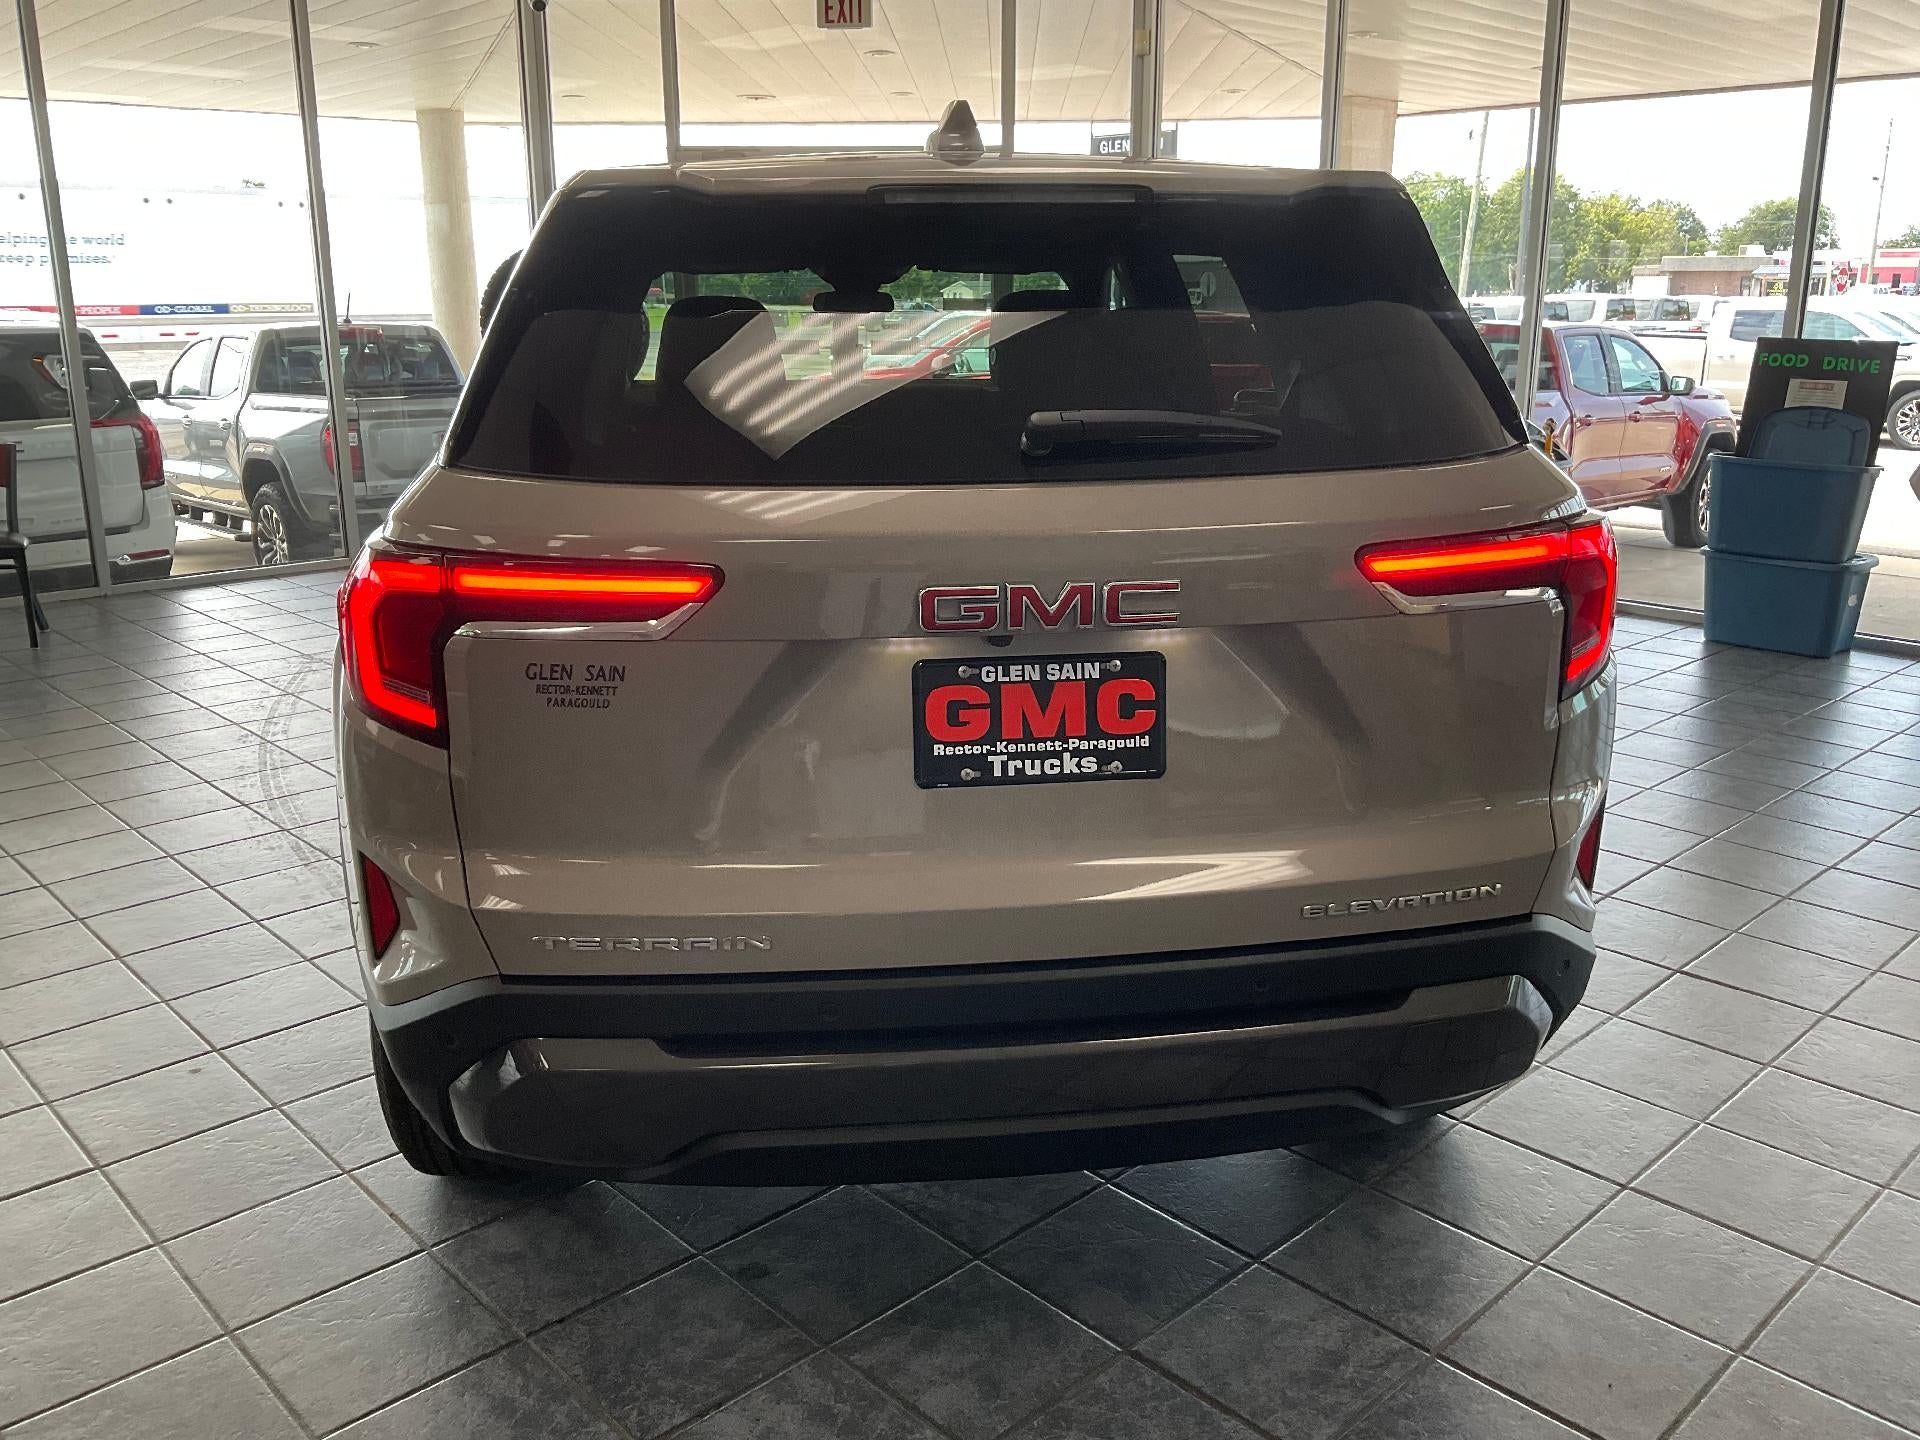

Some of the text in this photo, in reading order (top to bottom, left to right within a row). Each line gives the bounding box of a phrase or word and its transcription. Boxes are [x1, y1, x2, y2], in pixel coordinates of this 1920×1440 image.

[824, 0, 863, 24] EXIT
[1099, 138, 1130, 154] GLEN
[0, 231, 49, 247] elping
[81, 233, 125, 245] world
[40, 252, 112, 267] pmises.
[75, 306, 121, 315] -PEOPLE
[1758, 352, 1881, 374] FOOD DRIVE
[919, 579, 1181, 633] GMC
[525, 662, 627, 682] GLEN SAIN
[981, 661, 1100, 683] GLEN SAIN
[535, 684, 618, 696] RECTOR-KENNETT
[546, 697, 611, 709] PARAGOULD
[925, 678, 1157, 742] GMC
[933, 735, 1150, 757] Rector-Kennett-Paragould
[987, 751, 1099, 778] Trucks
[1301, 882, 1502, 919] ELEVATION
[530, 935, 773, 951] TERRAIN
